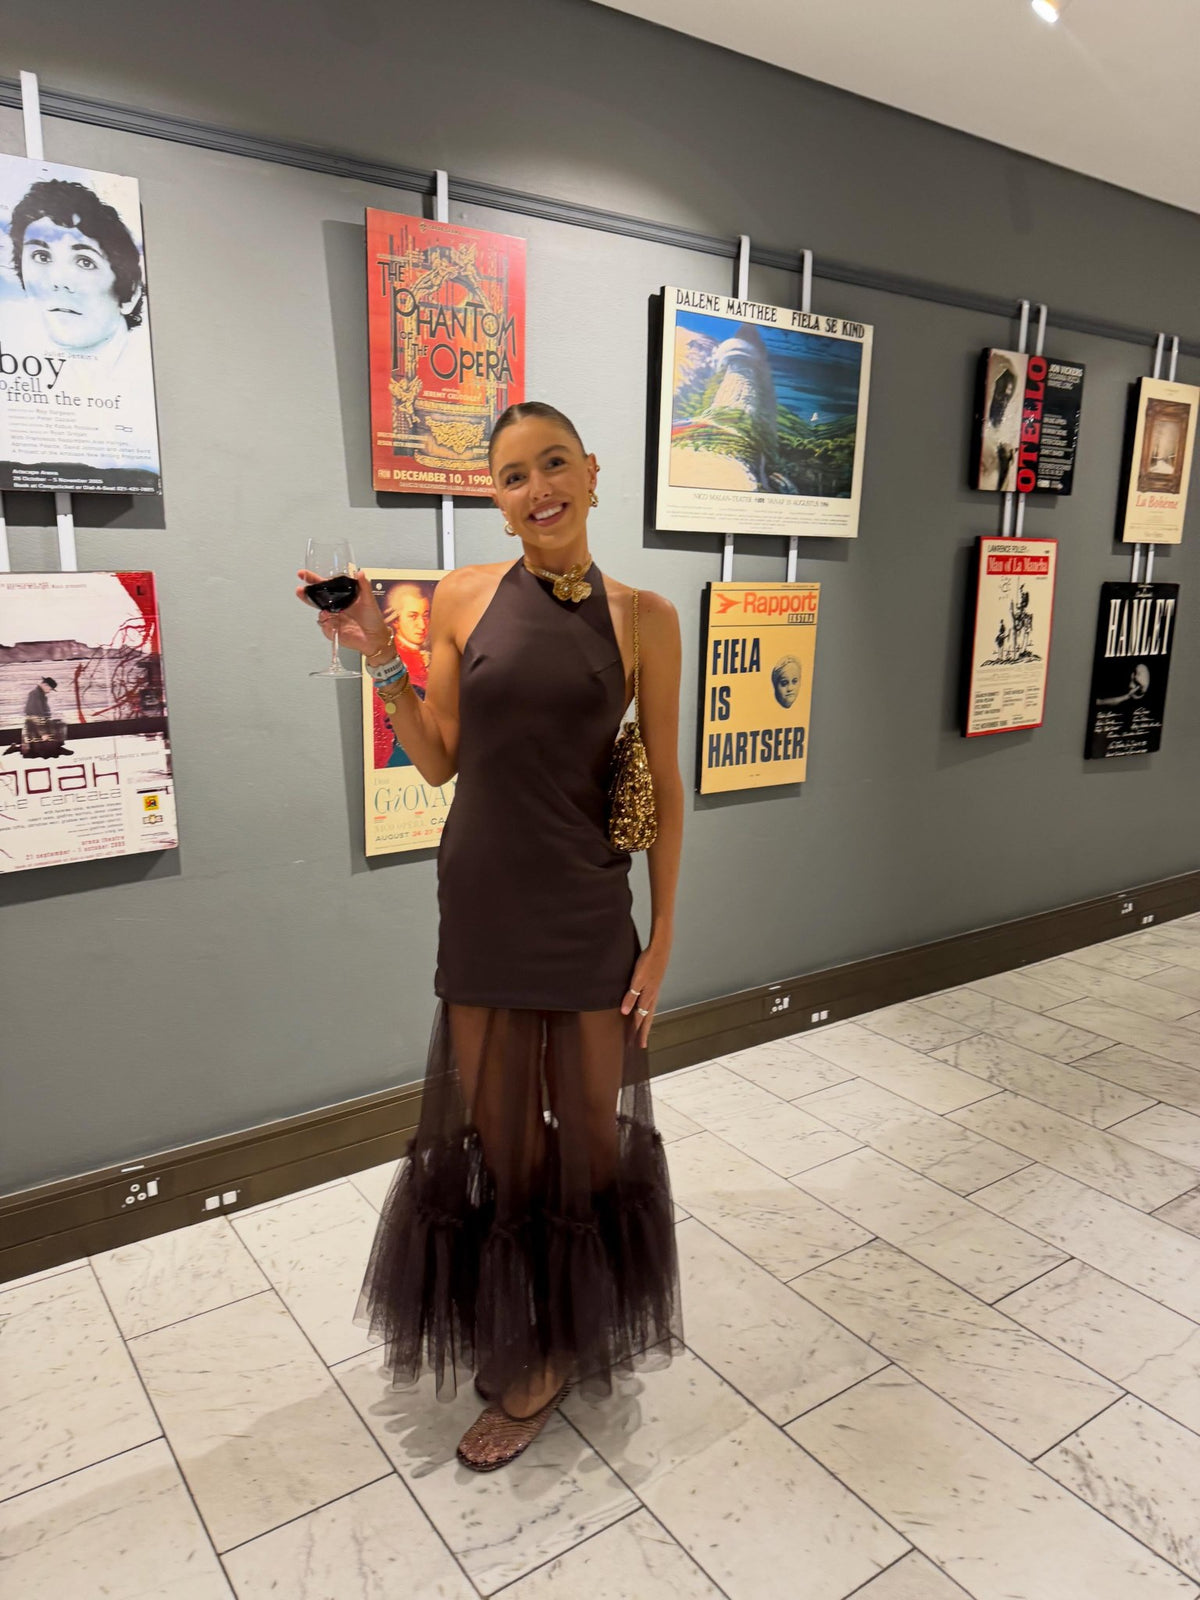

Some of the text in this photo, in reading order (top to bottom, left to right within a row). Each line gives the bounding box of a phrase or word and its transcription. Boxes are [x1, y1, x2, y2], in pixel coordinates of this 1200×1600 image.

[377, 261, 405, 296] THE
[392, 286, 517, 370] PHANTOM
[676, 289, 865, 339] DALENE MATTHEE FIELA SE KIND
[400, 331, 414, 349] OF
[411, 343, 429, 361] THE
[0, 341, 67, 390] boy
[430, 343, 515, 384] OPERA
[7, 387, 121, 410] from the roof
[14, 376, 42, 393] fell
[1017, 356, 1048, 493] OTELLO
[393, 469, 447, 483] DECEMBER
[449, 473, 465, 486] 10,
[468, 474, 493, 486] 1990
[743, 591, 817, 617] Rapport
[788, 614, 814, 623] EKSTRA
[1104, 599, 1176, 658] HAMLET
[712, 637, 761, 676] FIELA
[710, 686, 731, 722] IS
[708, 726, 805, 769] HARTSEER
[374, 781, 456, 814] GiOVA
[376, 832, 410, 842] AUGUST
